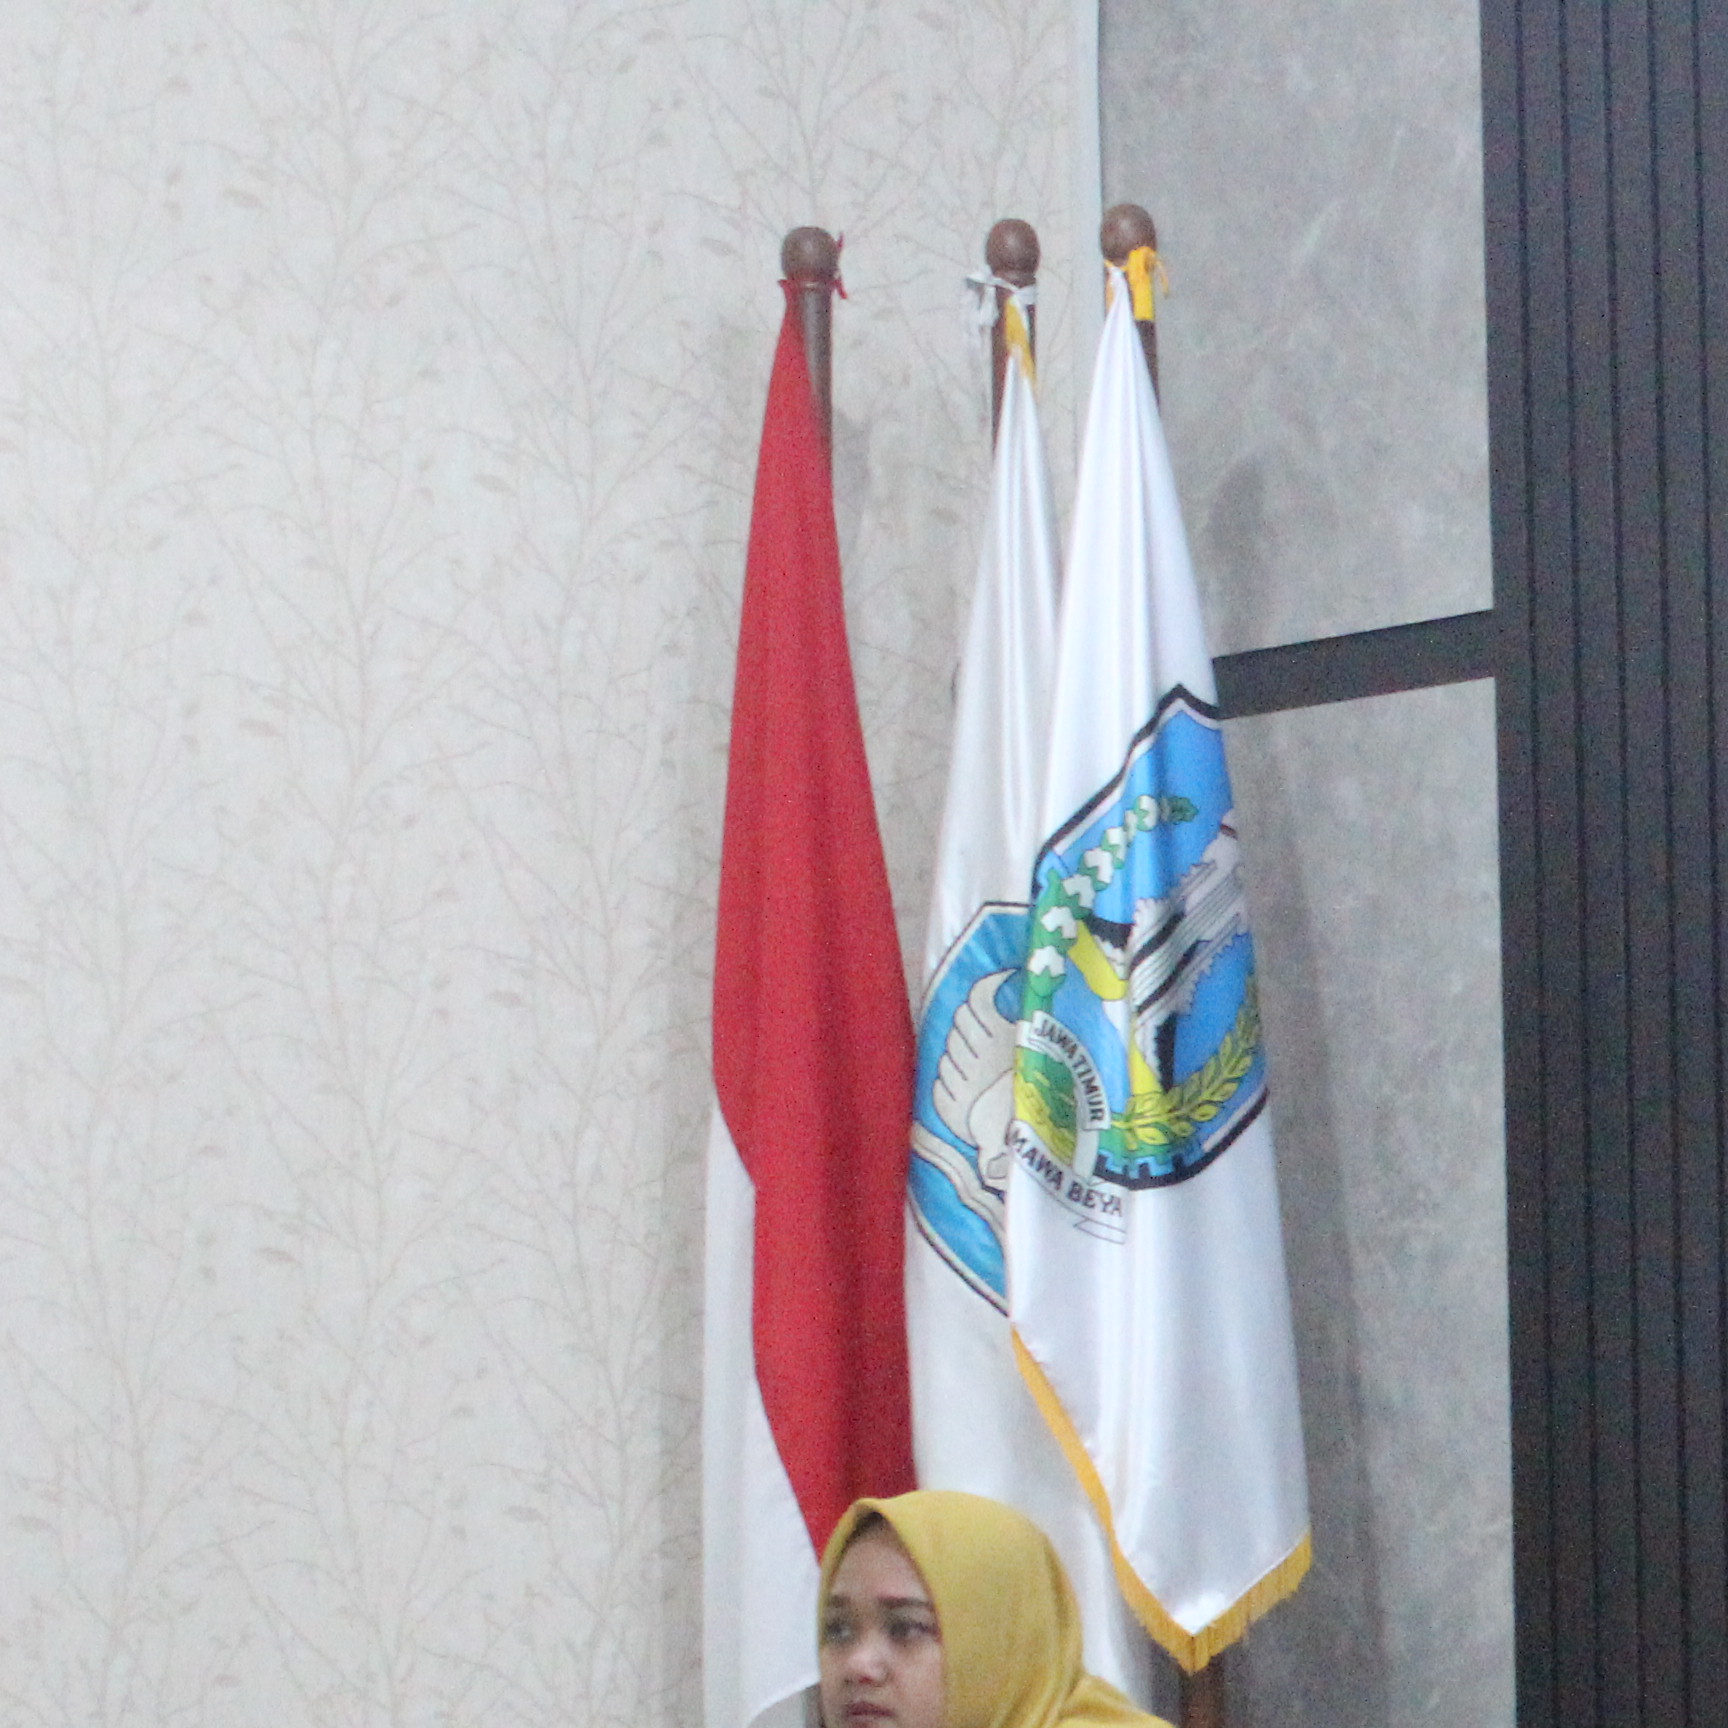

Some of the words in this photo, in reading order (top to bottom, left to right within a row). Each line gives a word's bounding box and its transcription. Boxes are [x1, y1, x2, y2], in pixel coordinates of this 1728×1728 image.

[1035, 1019, 1079, 1061] JAWA
[1072, 1054, 1105, 1122] TIMUR
[1066, 1180, 1123, 1217] BEYA
